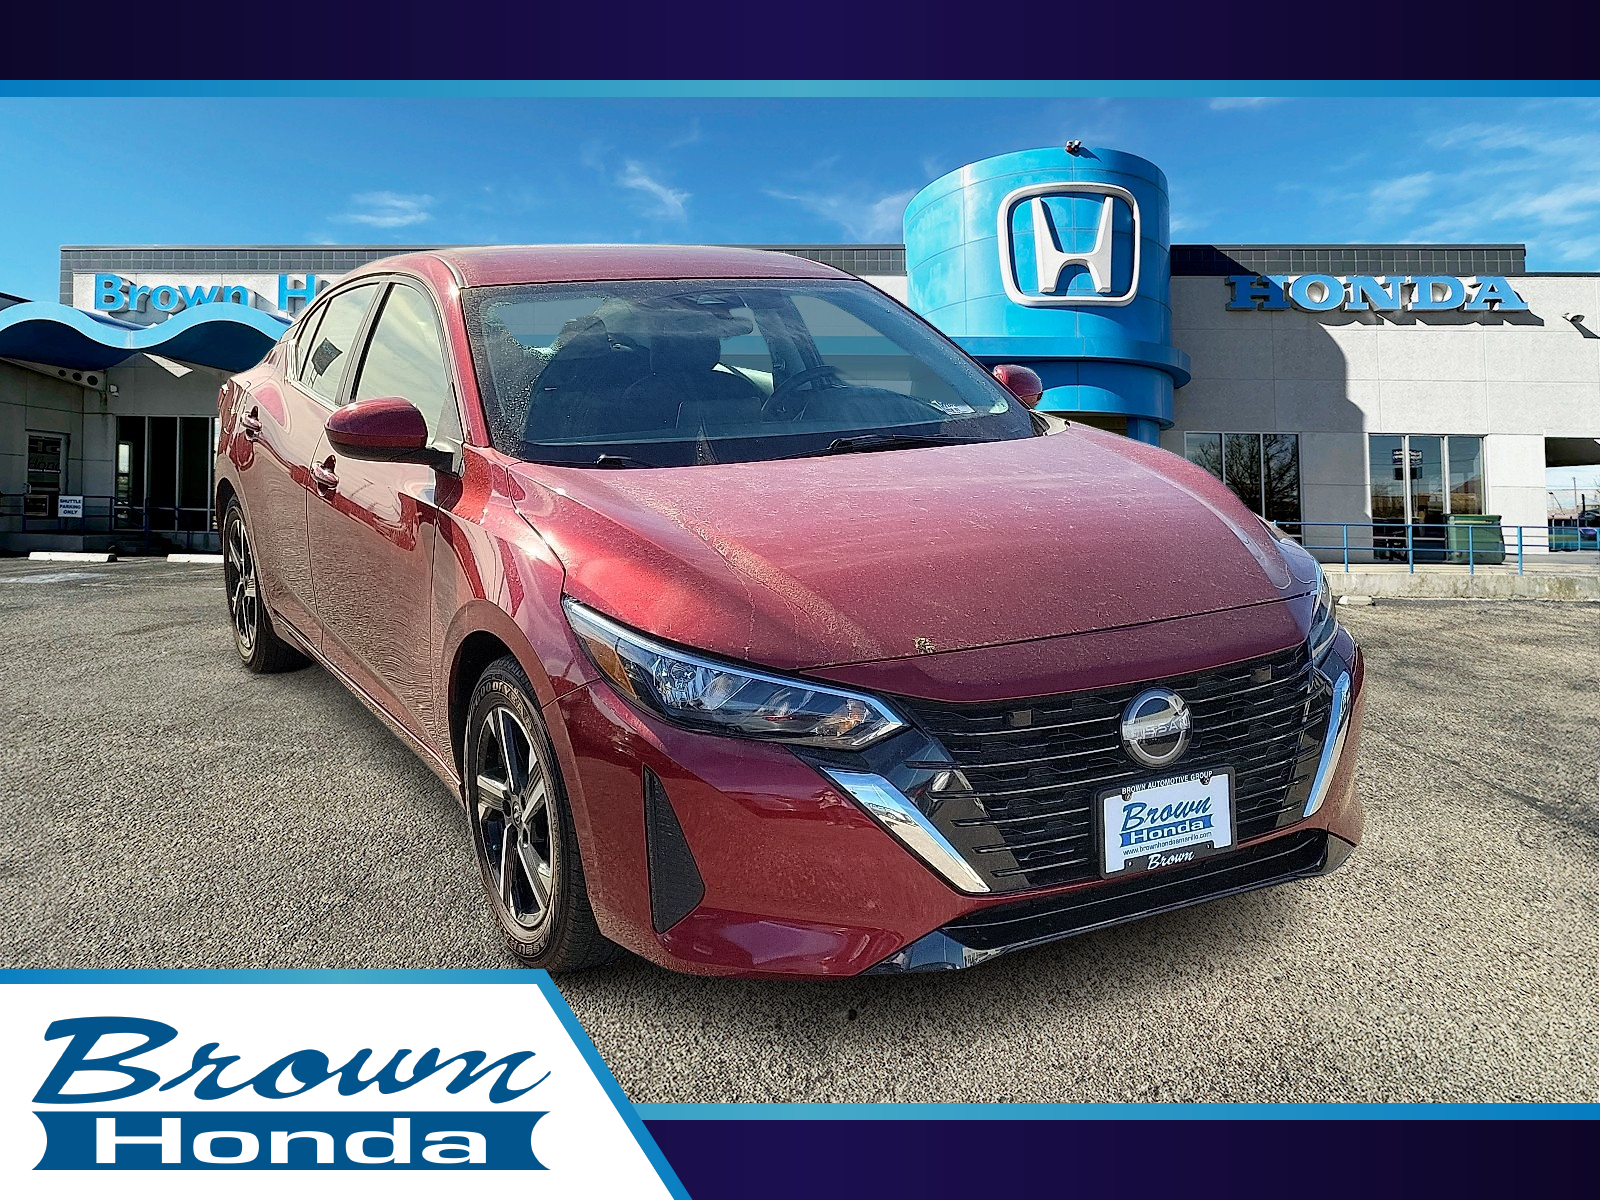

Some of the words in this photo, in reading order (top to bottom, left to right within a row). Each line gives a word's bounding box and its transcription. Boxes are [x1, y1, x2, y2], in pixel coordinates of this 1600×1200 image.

[94, 273, 250, 311] Brown
[278, 273, 317, 311] H
[1225, 274, 1528, 312] HONDA
[1124, 713, 1190, 740] NISSAN
[1121, 783, 1147, 795] BROWN
[1147, 774, 1189, 790] AUTOMOTIVE
[1190, 770, 1213, 781] GROUP
[1121, 797, 1211, 832] Brown
[1129, 818, 1205, 844] Honda
[1147, 851, 1195, 870] Brown
